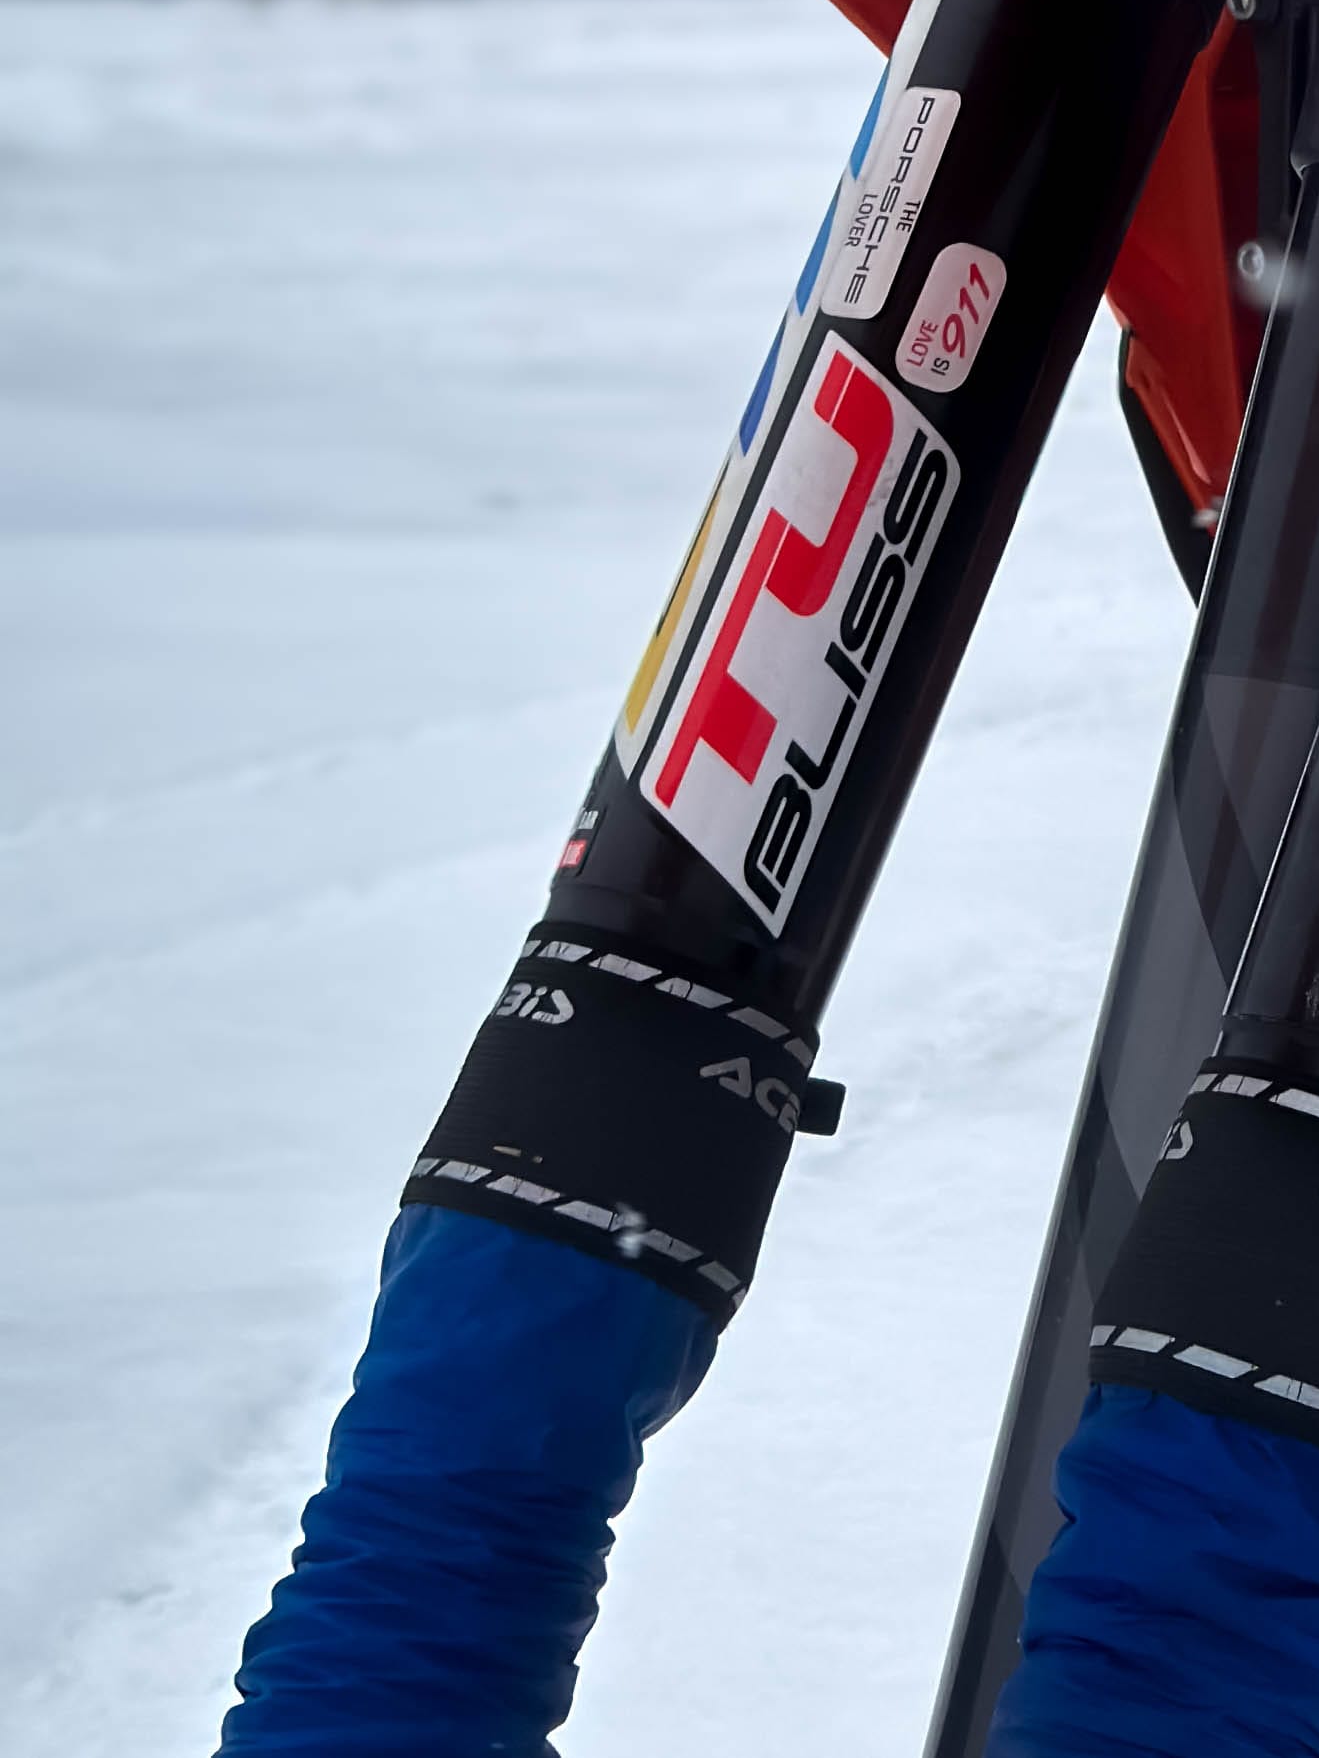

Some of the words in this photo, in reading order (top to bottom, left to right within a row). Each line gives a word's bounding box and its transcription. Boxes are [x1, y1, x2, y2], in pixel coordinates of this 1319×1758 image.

[844, 96, 935, 304] PORSCHE
[845, 193, 878, 247] LOVER
[895, 199, 921, 233] THE
[906, 319, 938, 367] LOVE
[930, 356, 950, 376] IS
[942, 262, 990, 359] 911
[655, 349, 895, 809] TU
[743, 426, 947, 915] BLISS
